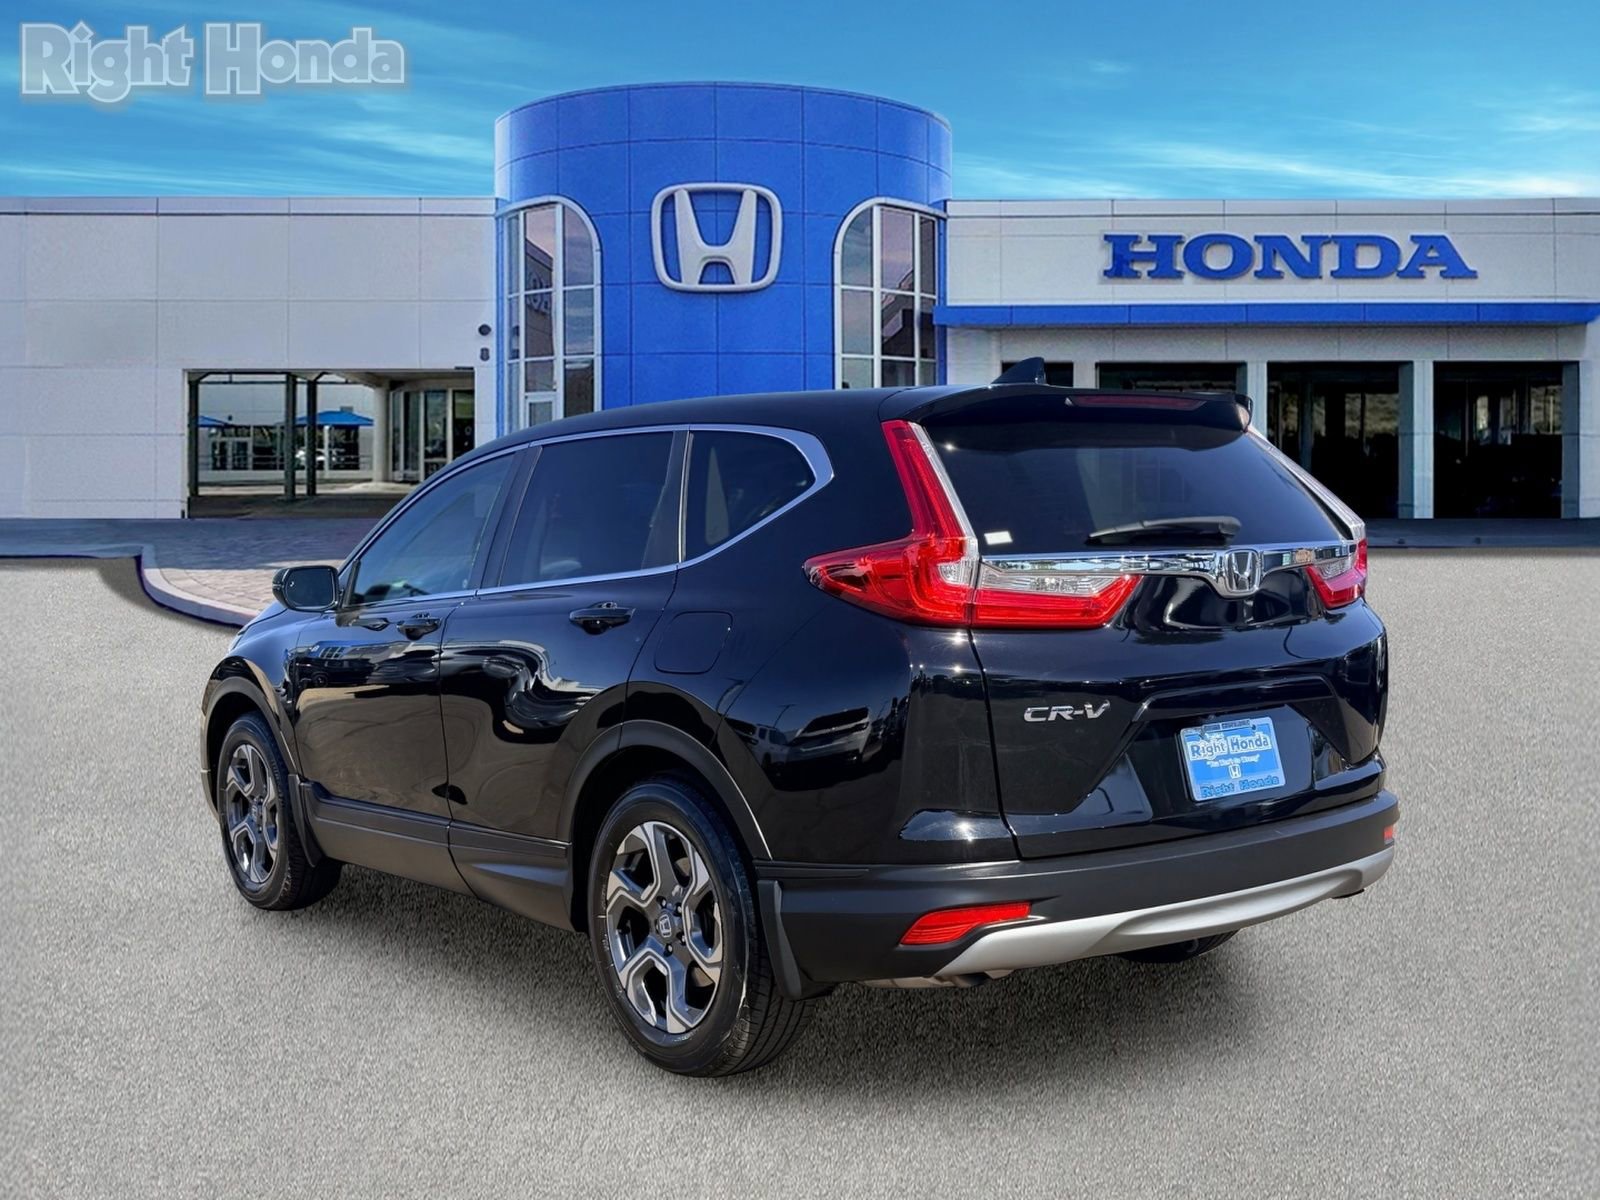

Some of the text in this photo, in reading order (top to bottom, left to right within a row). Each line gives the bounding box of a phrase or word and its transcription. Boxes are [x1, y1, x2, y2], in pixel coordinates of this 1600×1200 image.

[1103, 233, 1478, 280] HONDA
[1023, 699, 1111, 722] CR-V
[1189, 739, 1227, 758] Right
[1229, 734, 1271, 753] Honda
[1200, 775, 1280, 798] Right Honda
